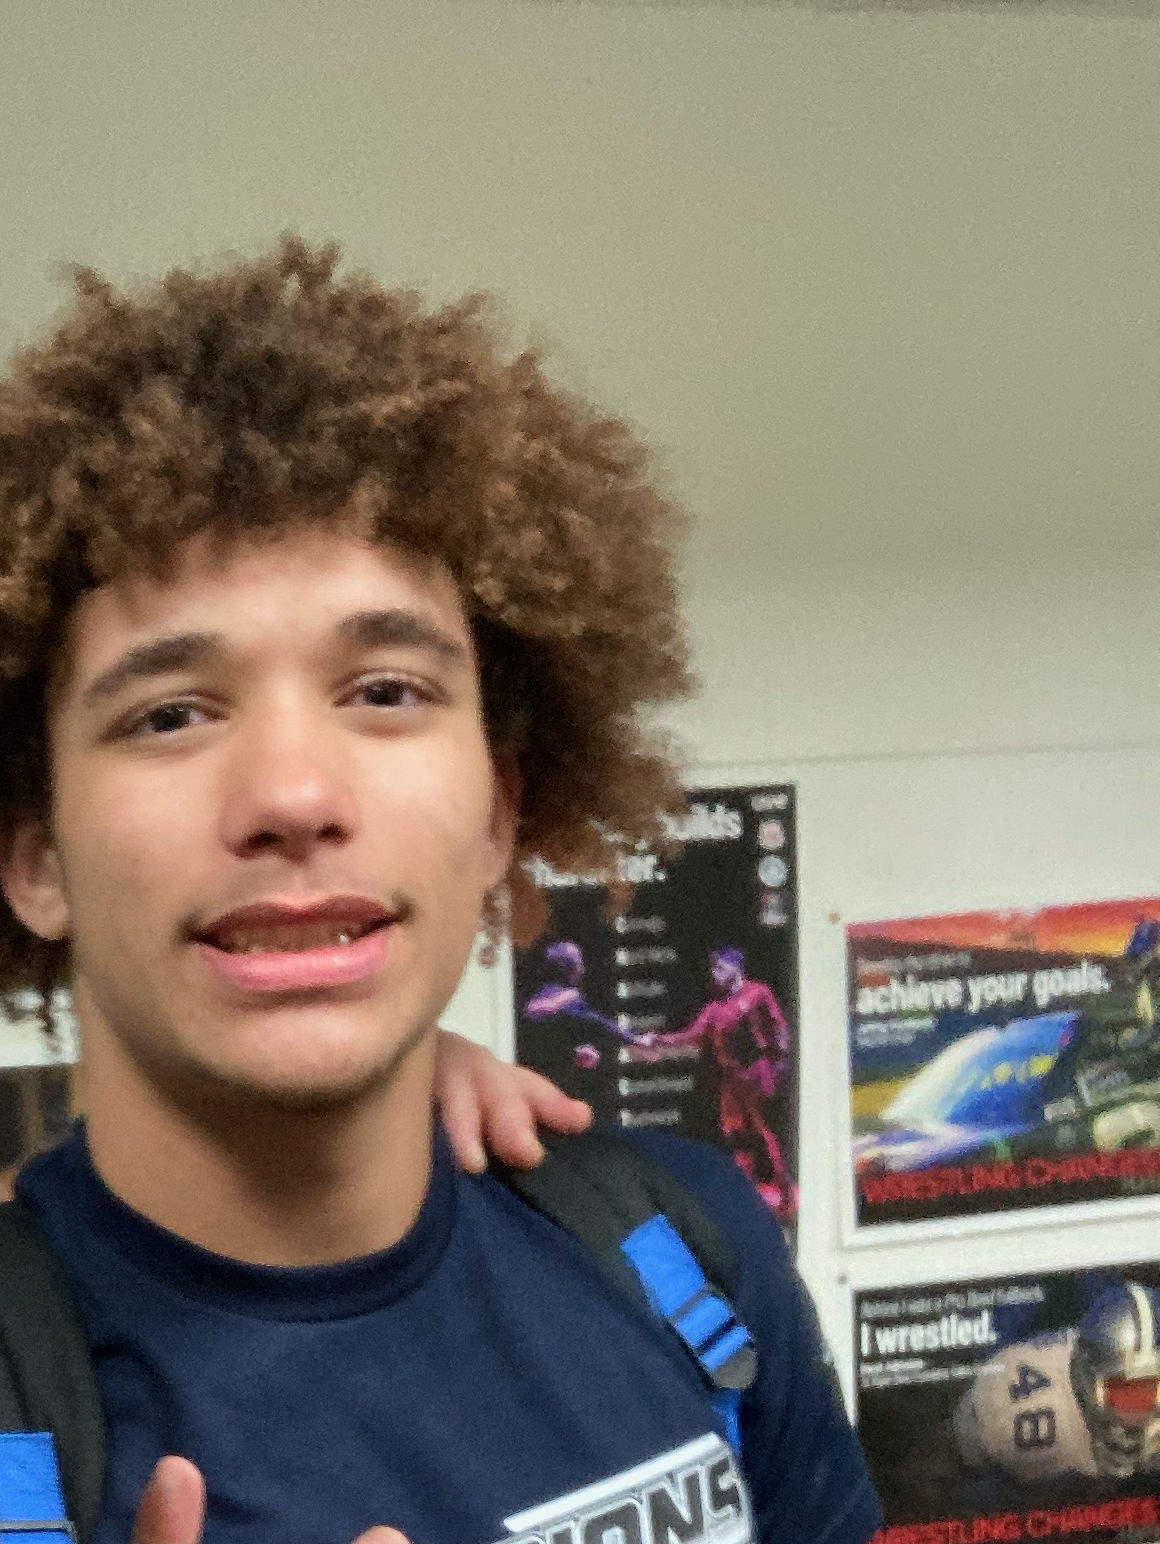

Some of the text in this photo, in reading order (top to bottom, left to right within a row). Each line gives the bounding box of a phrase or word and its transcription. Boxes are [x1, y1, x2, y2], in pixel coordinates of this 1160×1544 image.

[856, 957, 1111, 1014] achieve your goals.
[859, 1308, 998, 1357] I wrestled.
